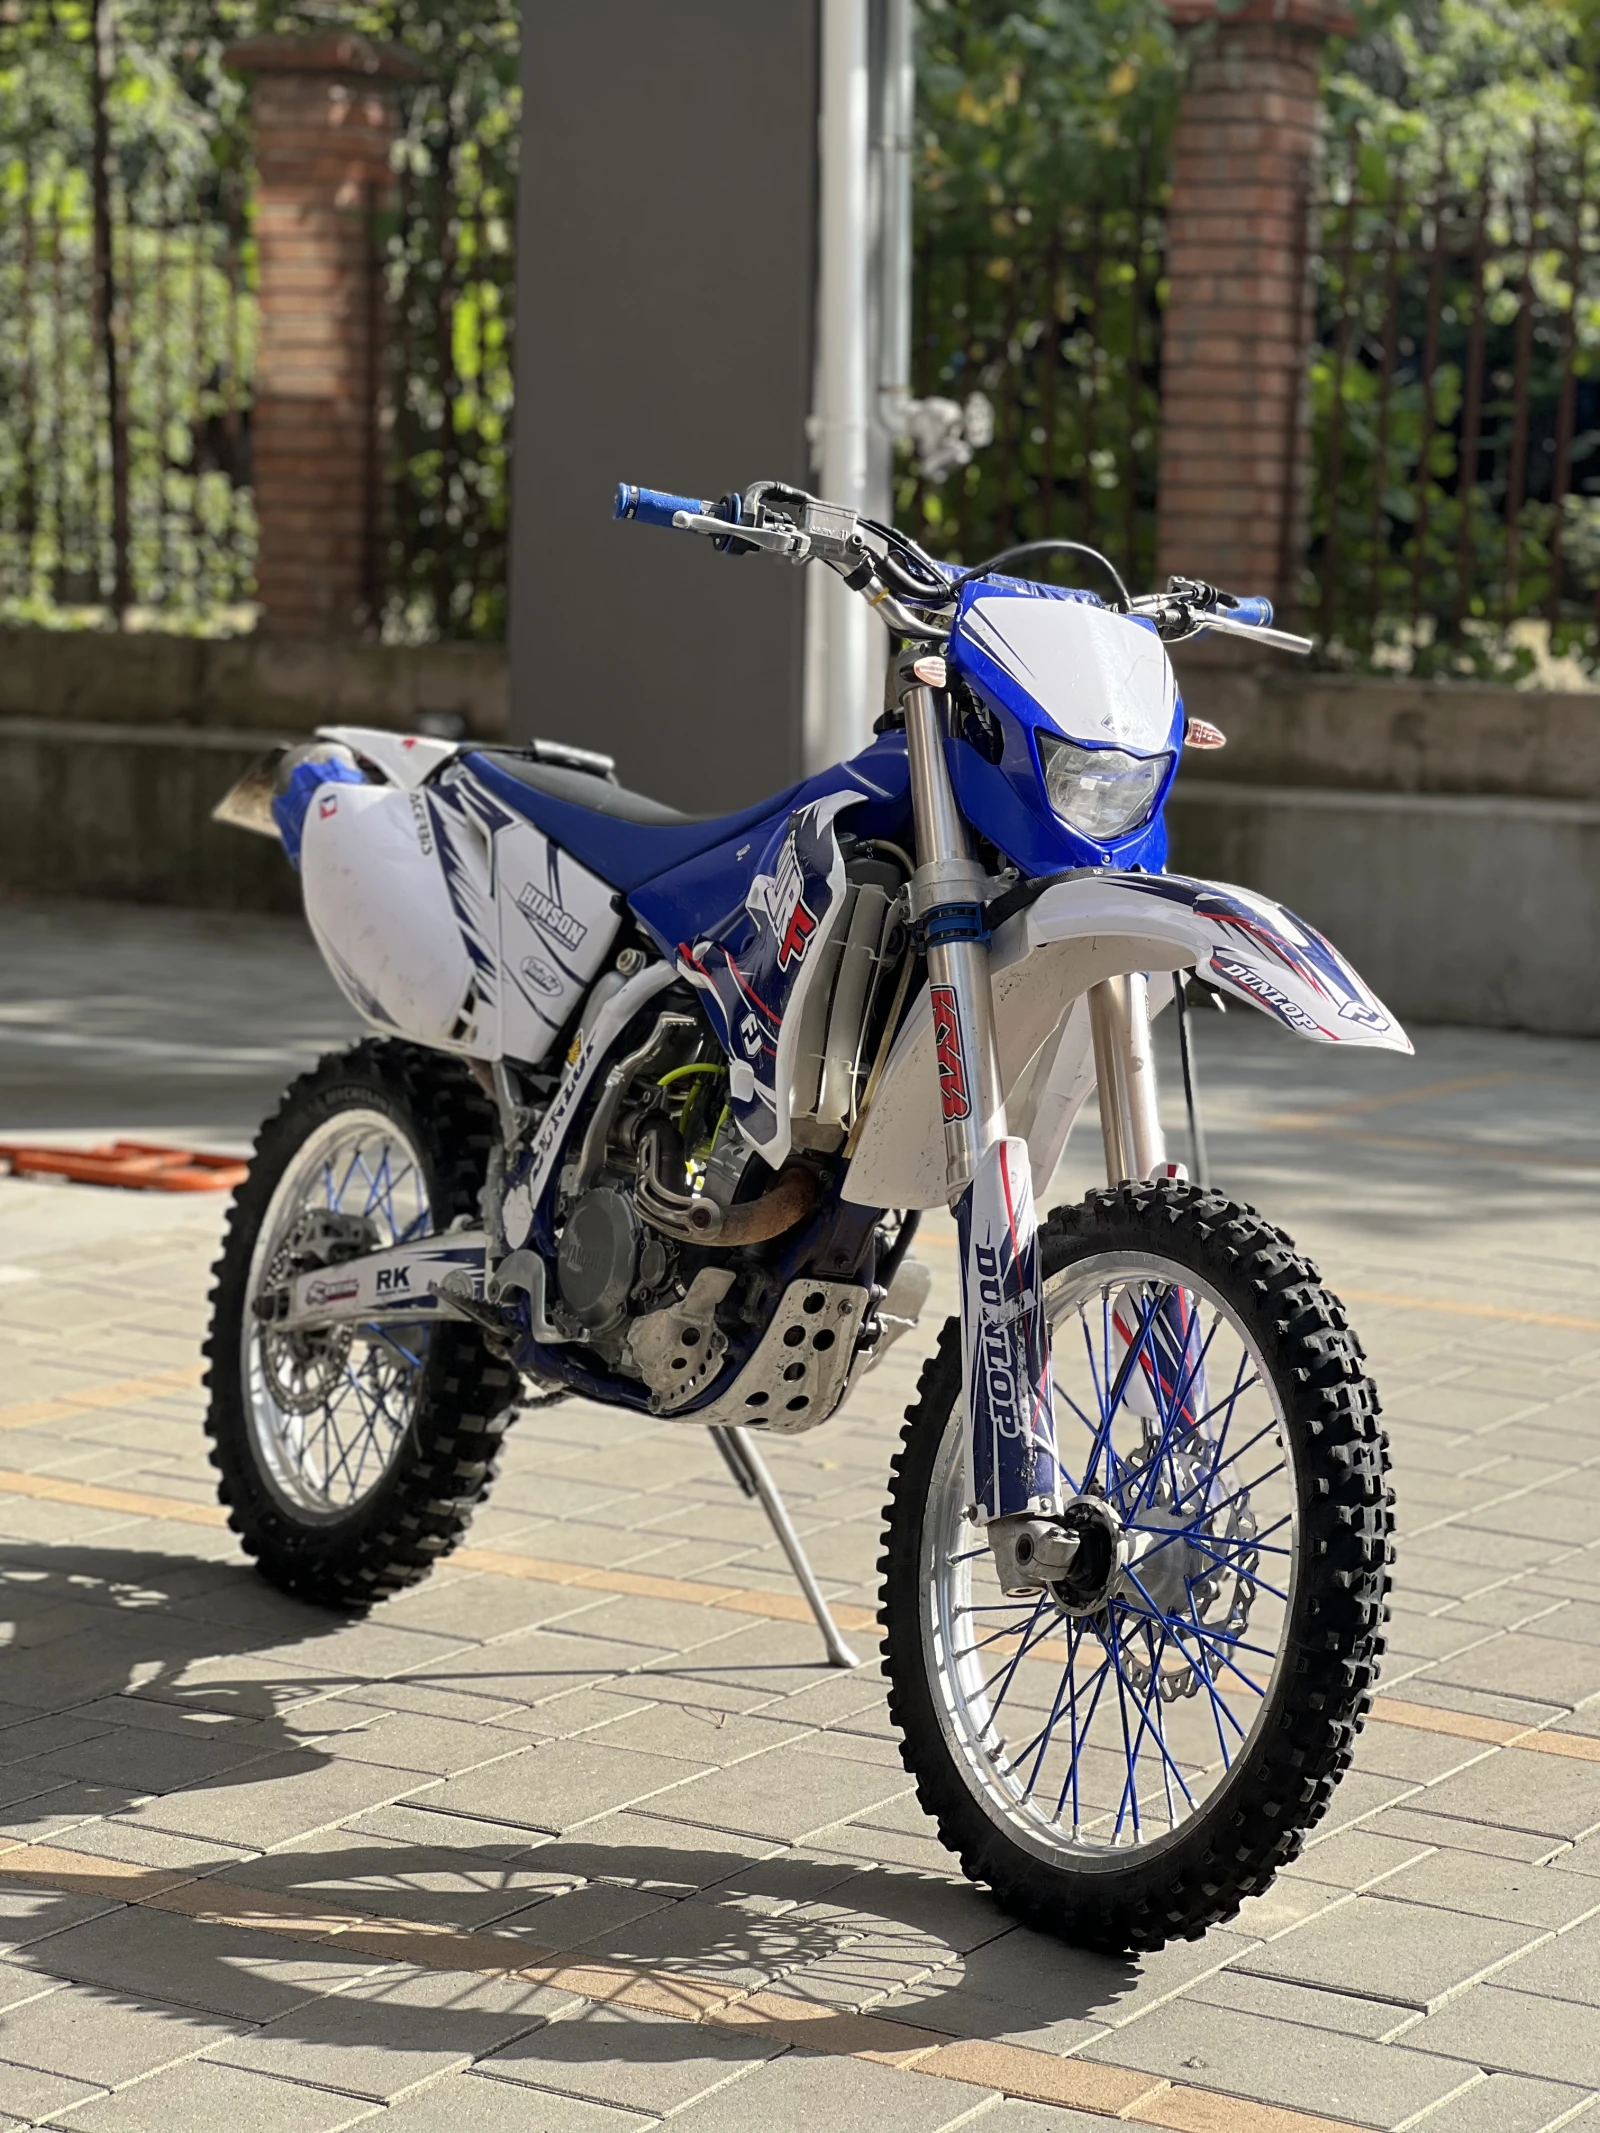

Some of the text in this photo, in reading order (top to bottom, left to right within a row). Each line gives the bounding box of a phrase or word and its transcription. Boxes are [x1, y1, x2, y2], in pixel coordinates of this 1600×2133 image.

[519, 882, 587, 946] HINSON
[1222, 963, 1319, 1030] DUNLOP
[376, 1266, 411, 1290] RK
[975, 1243, 1020, 1437] DUNLOP
